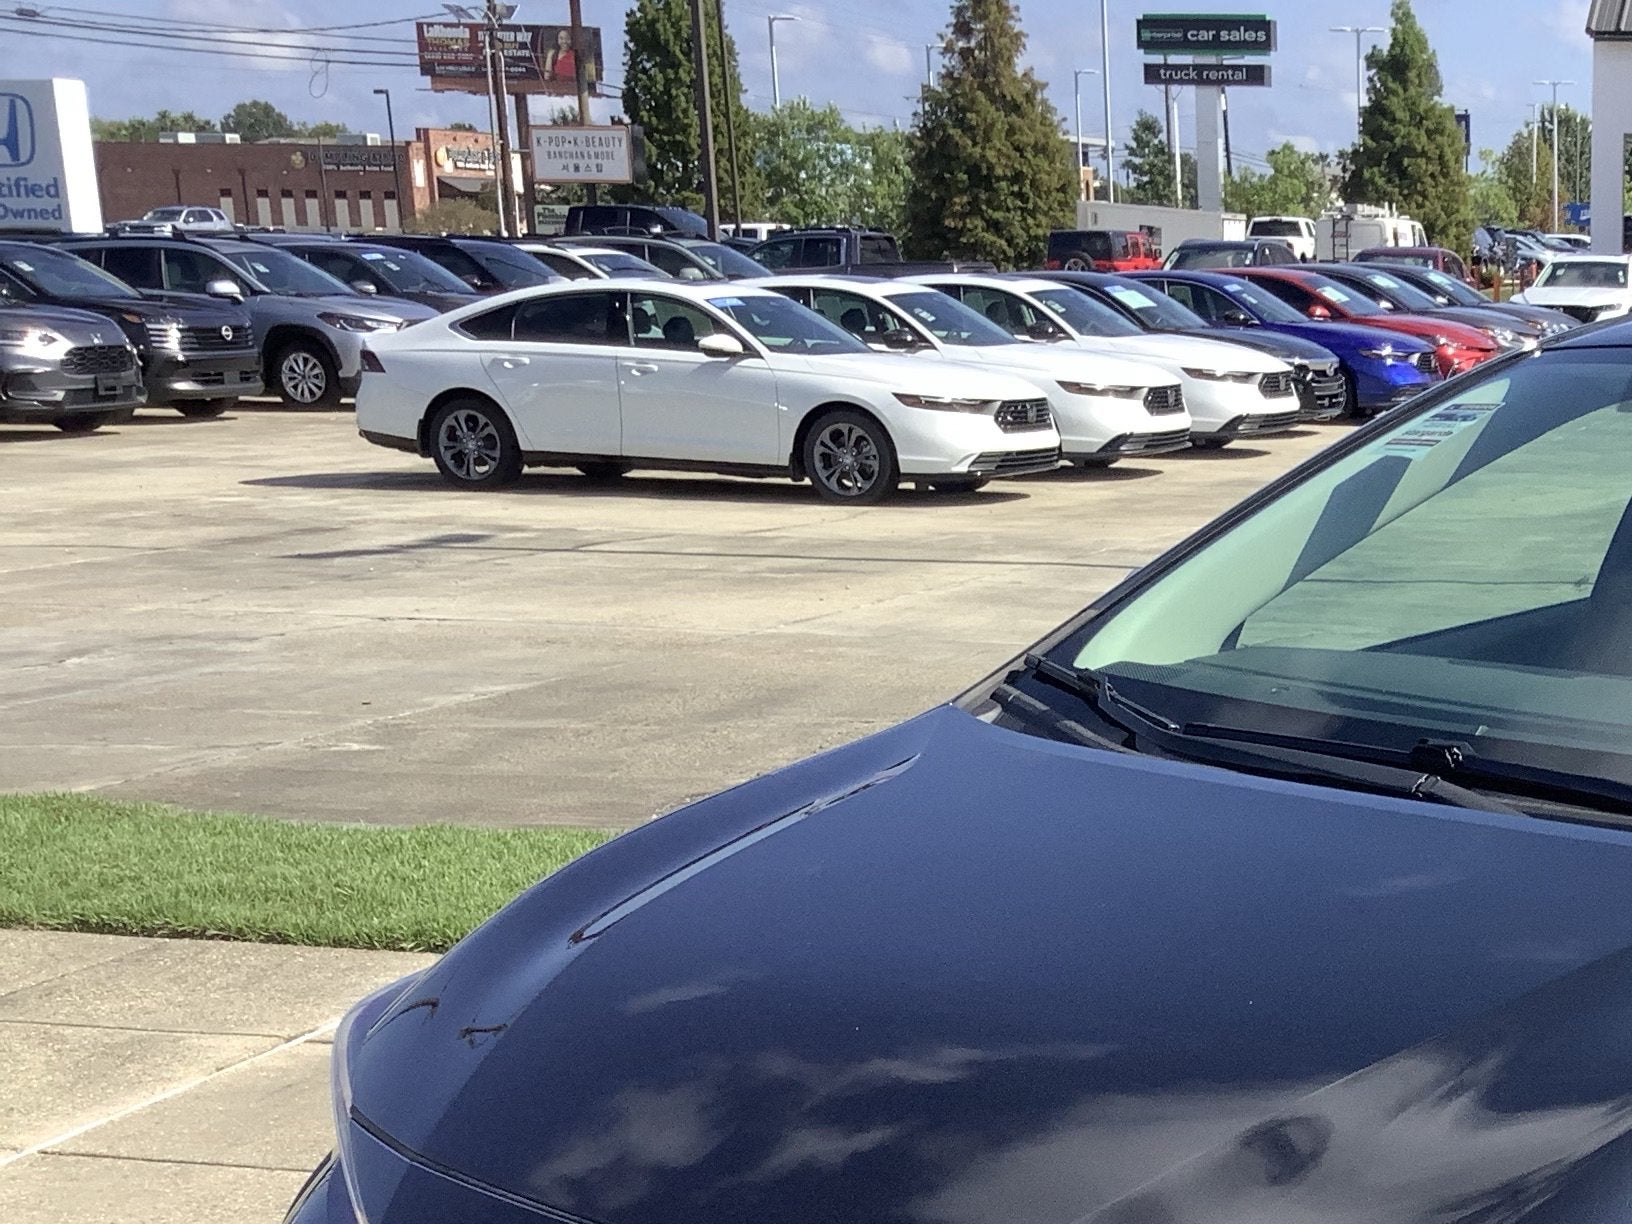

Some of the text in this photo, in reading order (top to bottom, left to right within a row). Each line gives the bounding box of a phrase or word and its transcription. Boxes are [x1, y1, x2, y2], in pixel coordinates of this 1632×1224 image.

[1187, 30, 1216, 41] car
[1219, 26, 1266, 42] sales
[1159, 66, 1246, 80] truck rental
